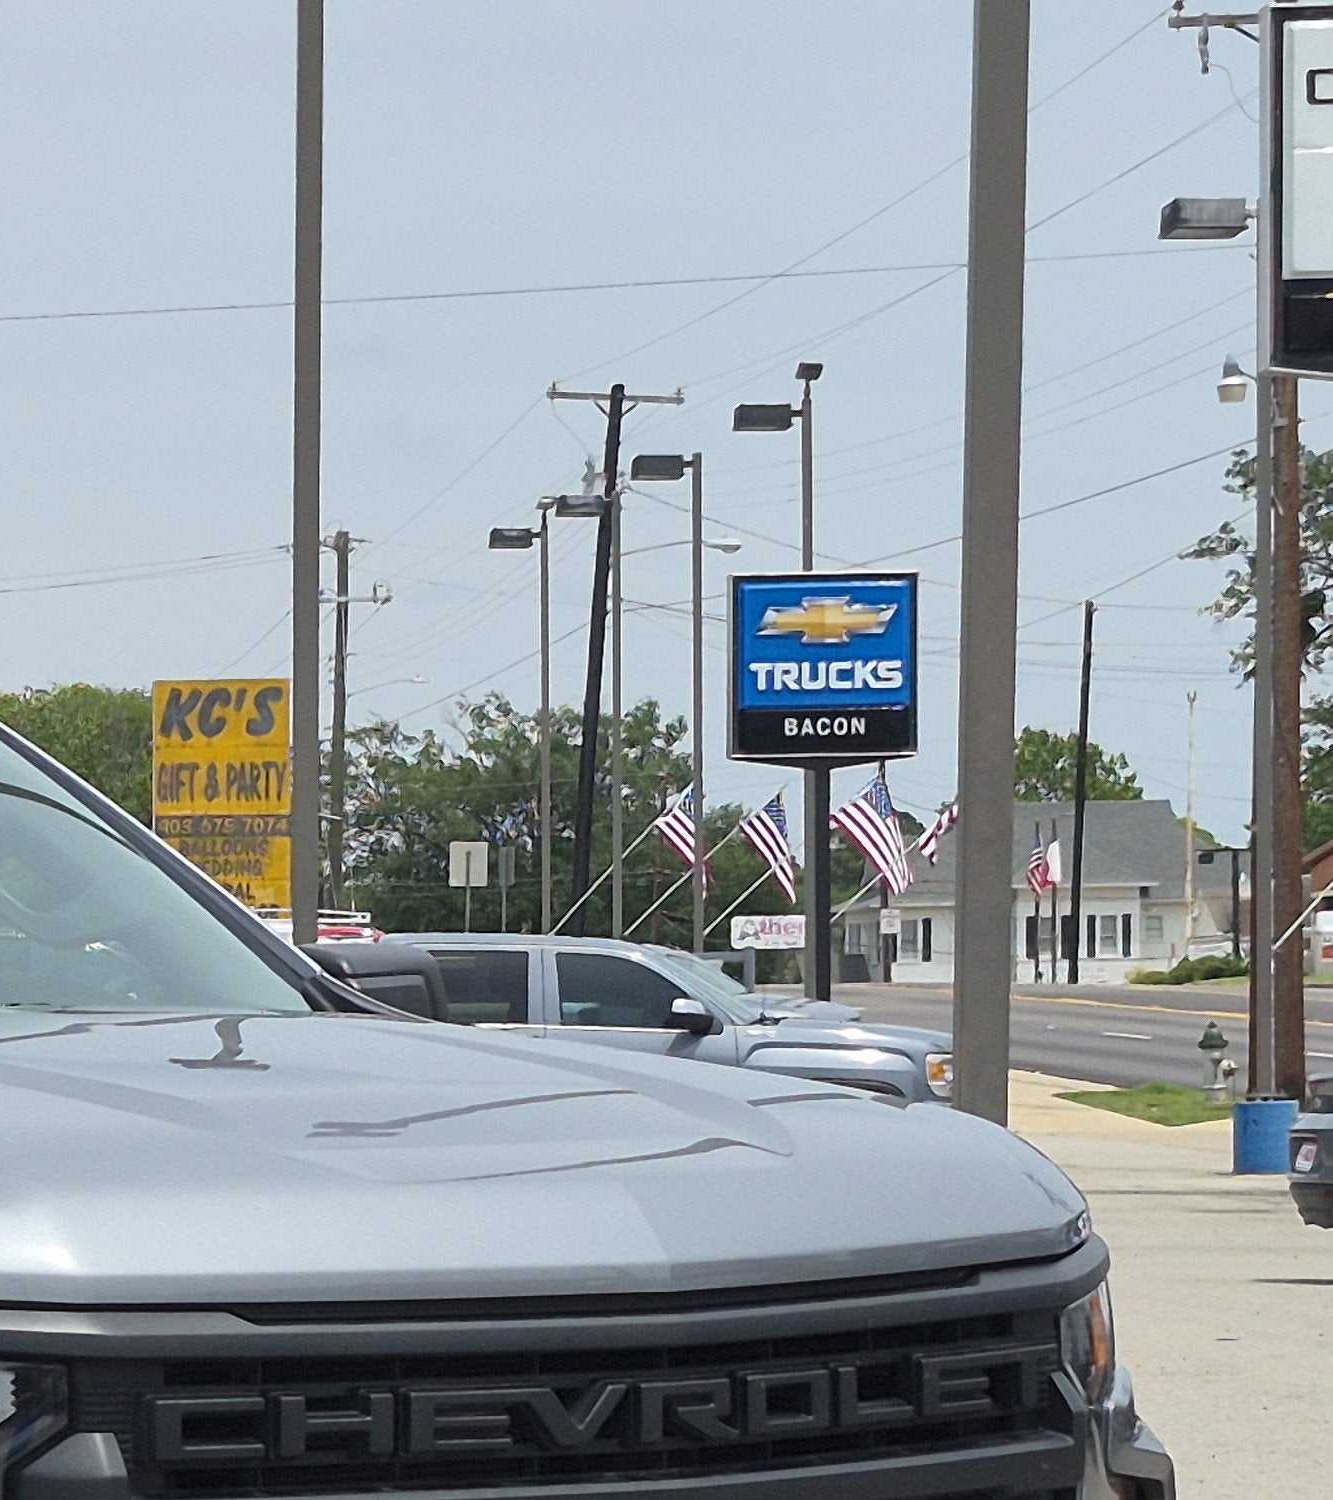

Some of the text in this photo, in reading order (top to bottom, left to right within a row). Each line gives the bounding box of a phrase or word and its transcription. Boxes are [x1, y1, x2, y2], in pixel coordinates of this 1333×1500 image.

[749, 660, 903, 691] TRUCKS
[159, 686, 284, 742] KC'S
[784, 717, 866, 736] BACON
[157, 761, 201, 804] GIFT
[226, 761, 288, 803] PARTY
[146, 1343, 1059, 1460] CHEVROLET
